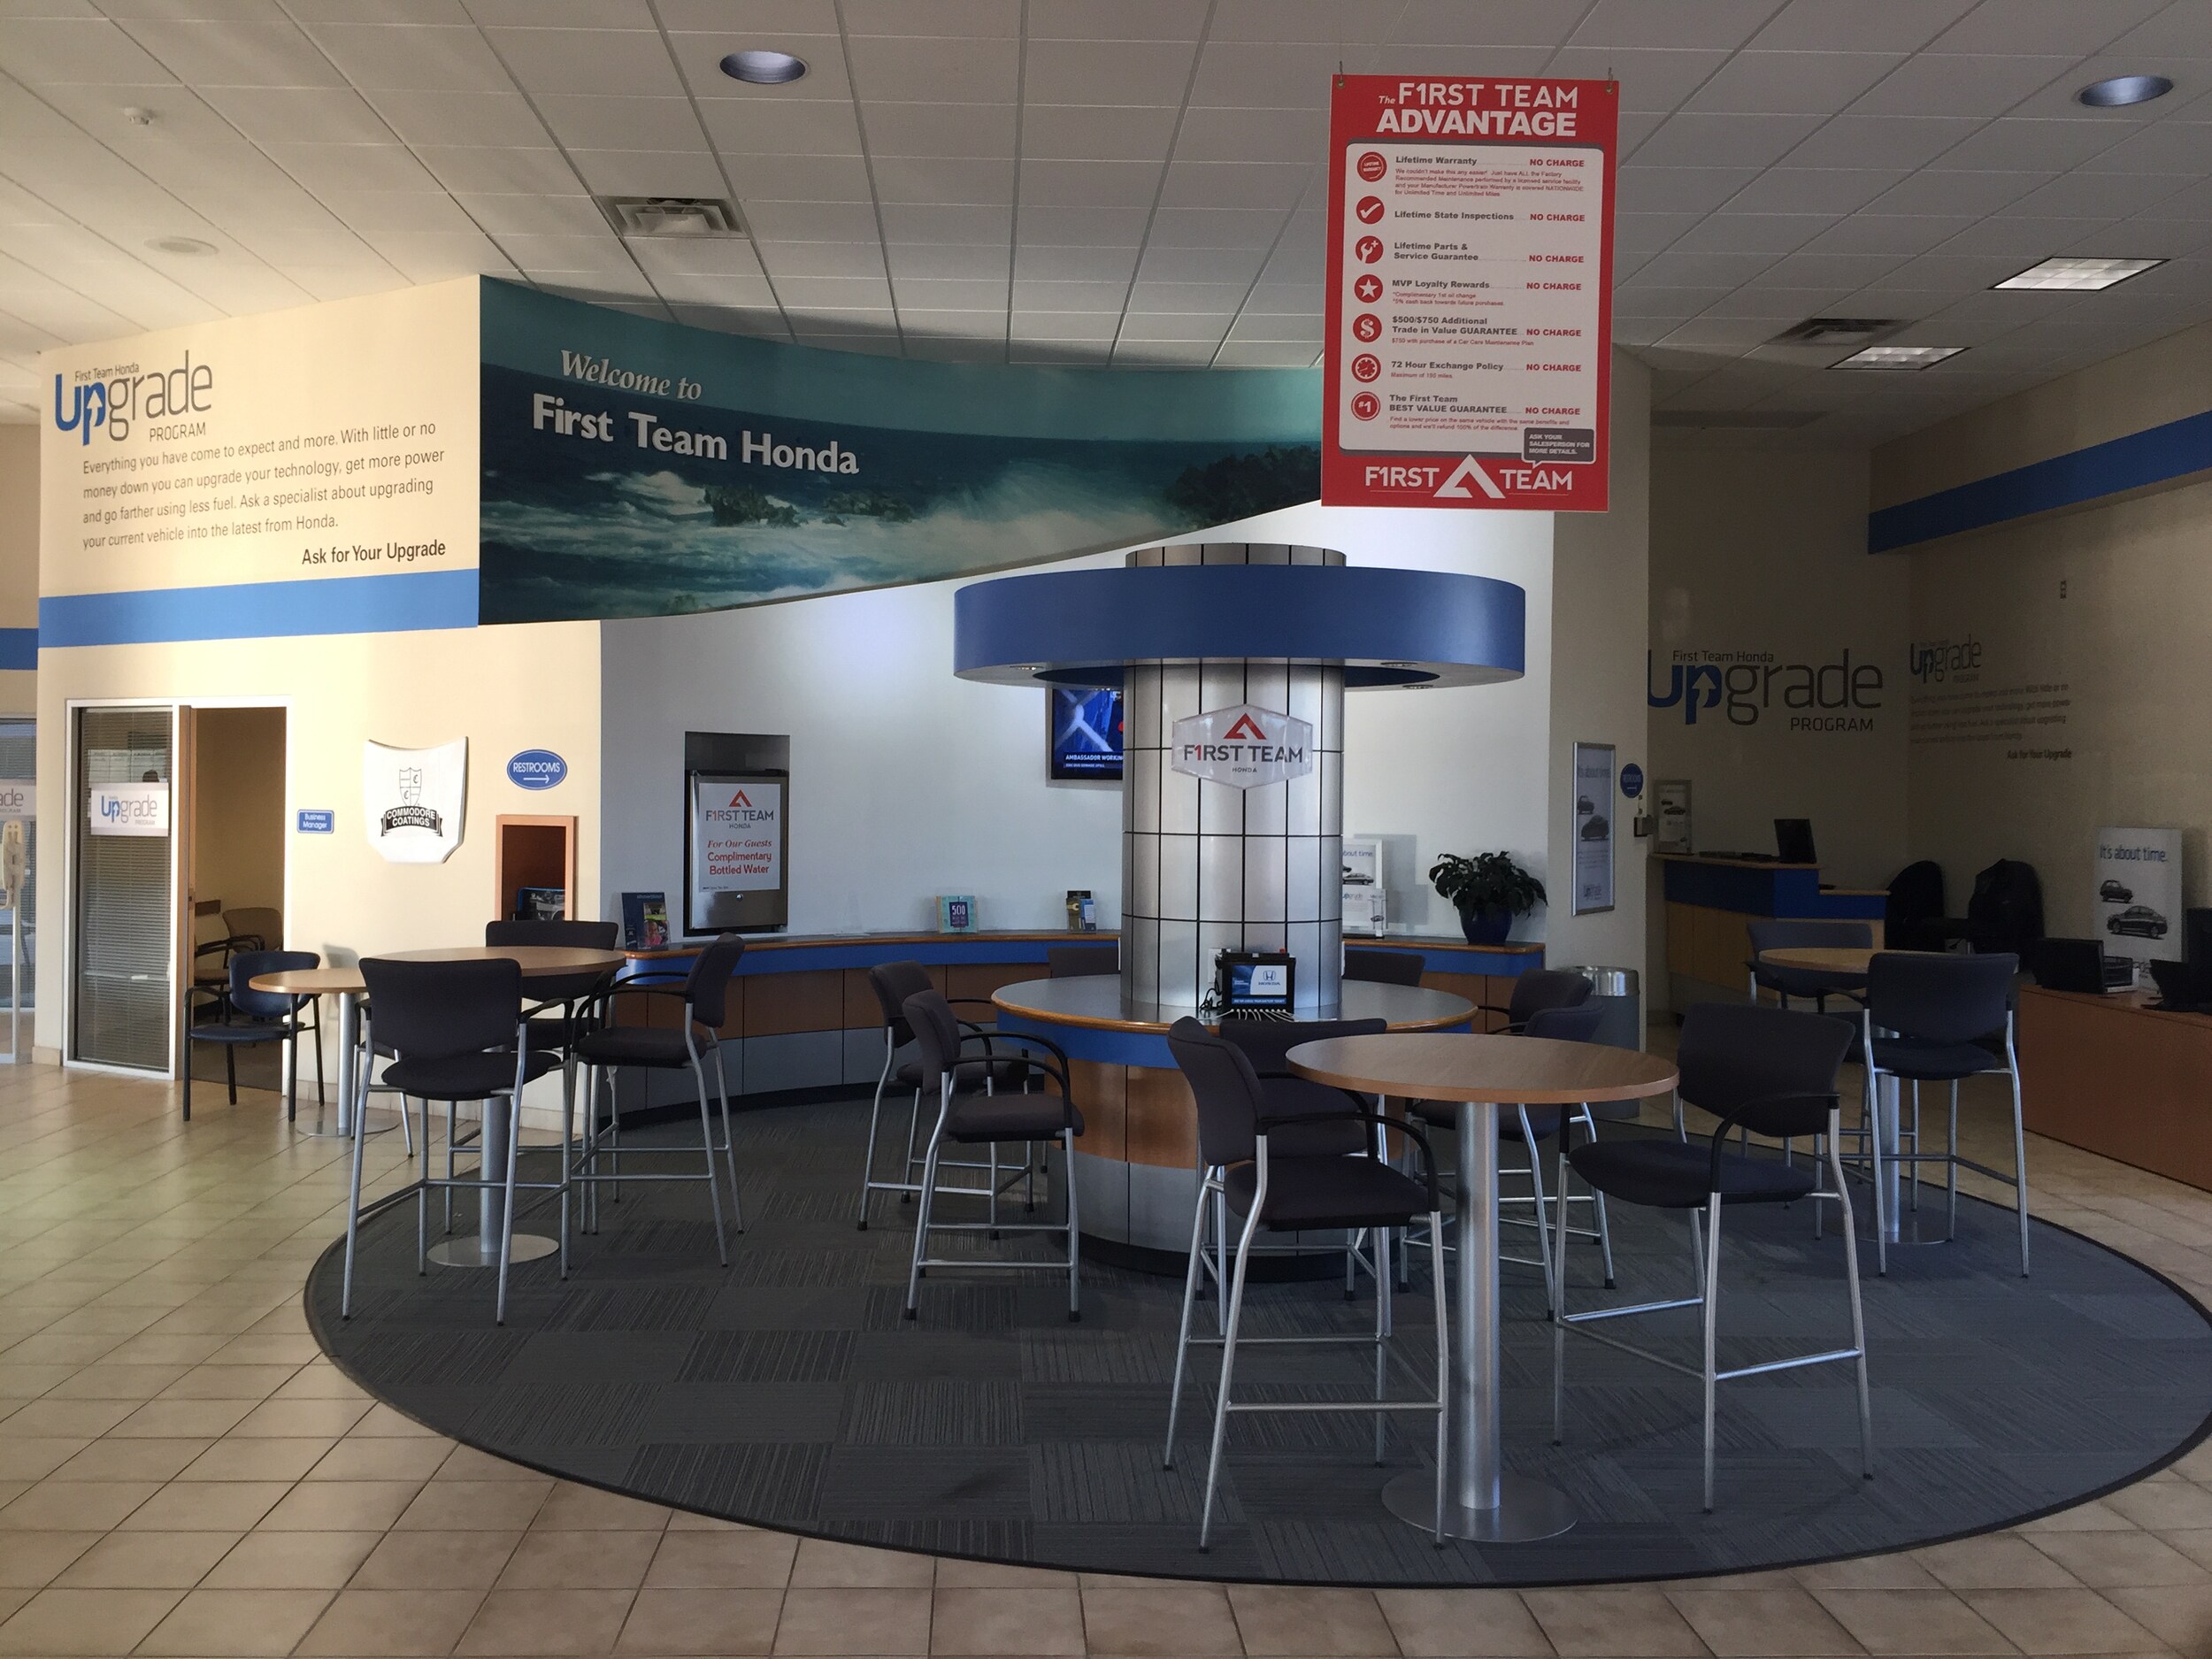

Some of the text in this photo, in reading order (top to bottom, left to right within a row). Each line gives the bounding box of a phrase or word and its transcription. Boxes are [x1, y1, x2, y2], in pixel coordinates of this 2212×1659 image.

[1379, 82, 1578, 108] The F1RST TEAM
[1376, 109, 1577, 137] ADVANTAGE
[1435, 157, 1478, 166] Warranty
[1461, 212, 1514, 221] Inspections
[1545, 255, 1584, 264] CHARGE
[1415, 280, 1448, 289] Loyalty
[75, 362, 140, 381] First Team Honda
[1430, 362, 1474, 371] Exchange
[1476, 362, 1504, 372] Policy
[560, 349, 703, 401] Welcome to
[1389, 394, 1408, 403] The
[1417, 404, 1448, 413] VALUE
[1450, 405, 1508, 414] GUARANTEE
[1541, 407, 1581, 416] CHARGE
[150, 422, 206, 442] PROGRAM
[533, 393, 860, 474] First Team Honda
[83, 423, 436, 474] Everything you have come to expect and more. With little or no
[83, 449, 444, 499] money down you can upgrade your technology, get more power
[1365, 466, 1572, 490] F1RST TEAM
[83, 478, 434, 524] and go farther using less fuel. Ask a specialist about upgrading
[83, 513, 339, 550] your current vehicle into the latest from Honda.
[302, 539, 446, 565] Ask for Your Upgrade
[1672, 650, 1774, 663] First Team Honda
[1791, 718, 1873, 732] PROGRAM
[1184, 745, 1302, 763] F1RST TEAM
[512, 761, 561, 774] RESTROOMS
[386, 808, 436, 820] COMMODORE
[706, 810, 774, 821] F1RST TEAM
[303, 821, 328, 830] Manager
[392, 817, 430, 827] COATINGS
[707, 852, 772, 864] Complimentary
[2114, 844, 2140, 861] about
[710, 864, 770, 875] Bottled Water
[951, 905, 965, 916] 500
